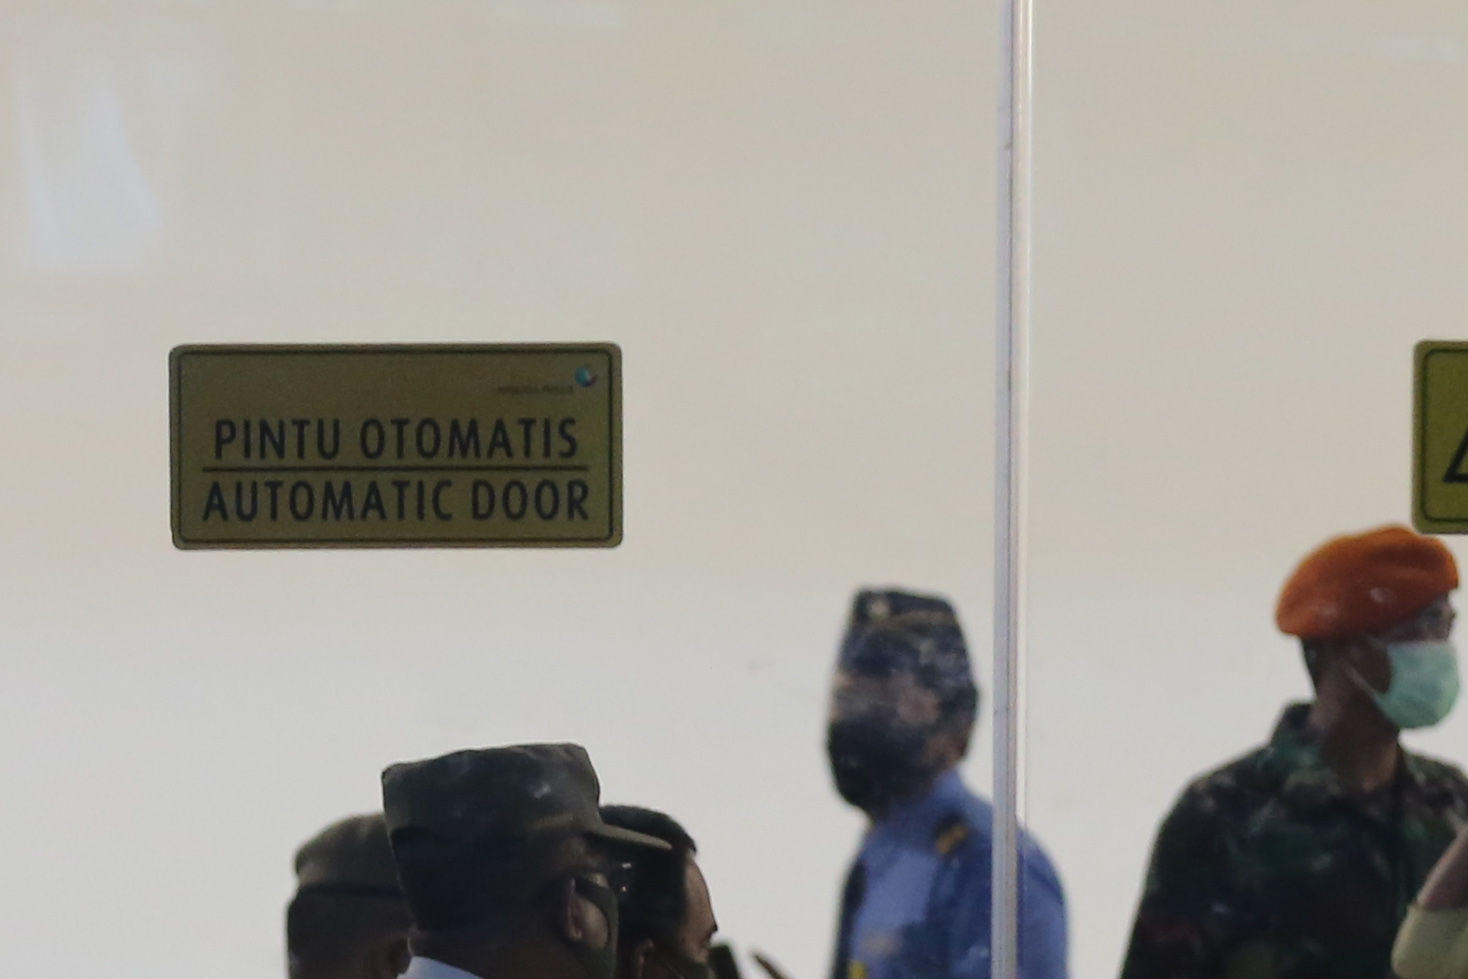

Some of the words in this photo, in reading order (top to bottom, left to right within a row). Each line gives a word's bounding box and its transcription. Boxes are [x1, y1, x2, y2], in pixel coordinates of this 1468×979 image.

[214, 418, 341, 460] PINTU
[360, 417, 578, 460] OTOMATIS
[202, 479, 453, 522] AUTOMATIC
[471, 479, 590, 521] DOOR
